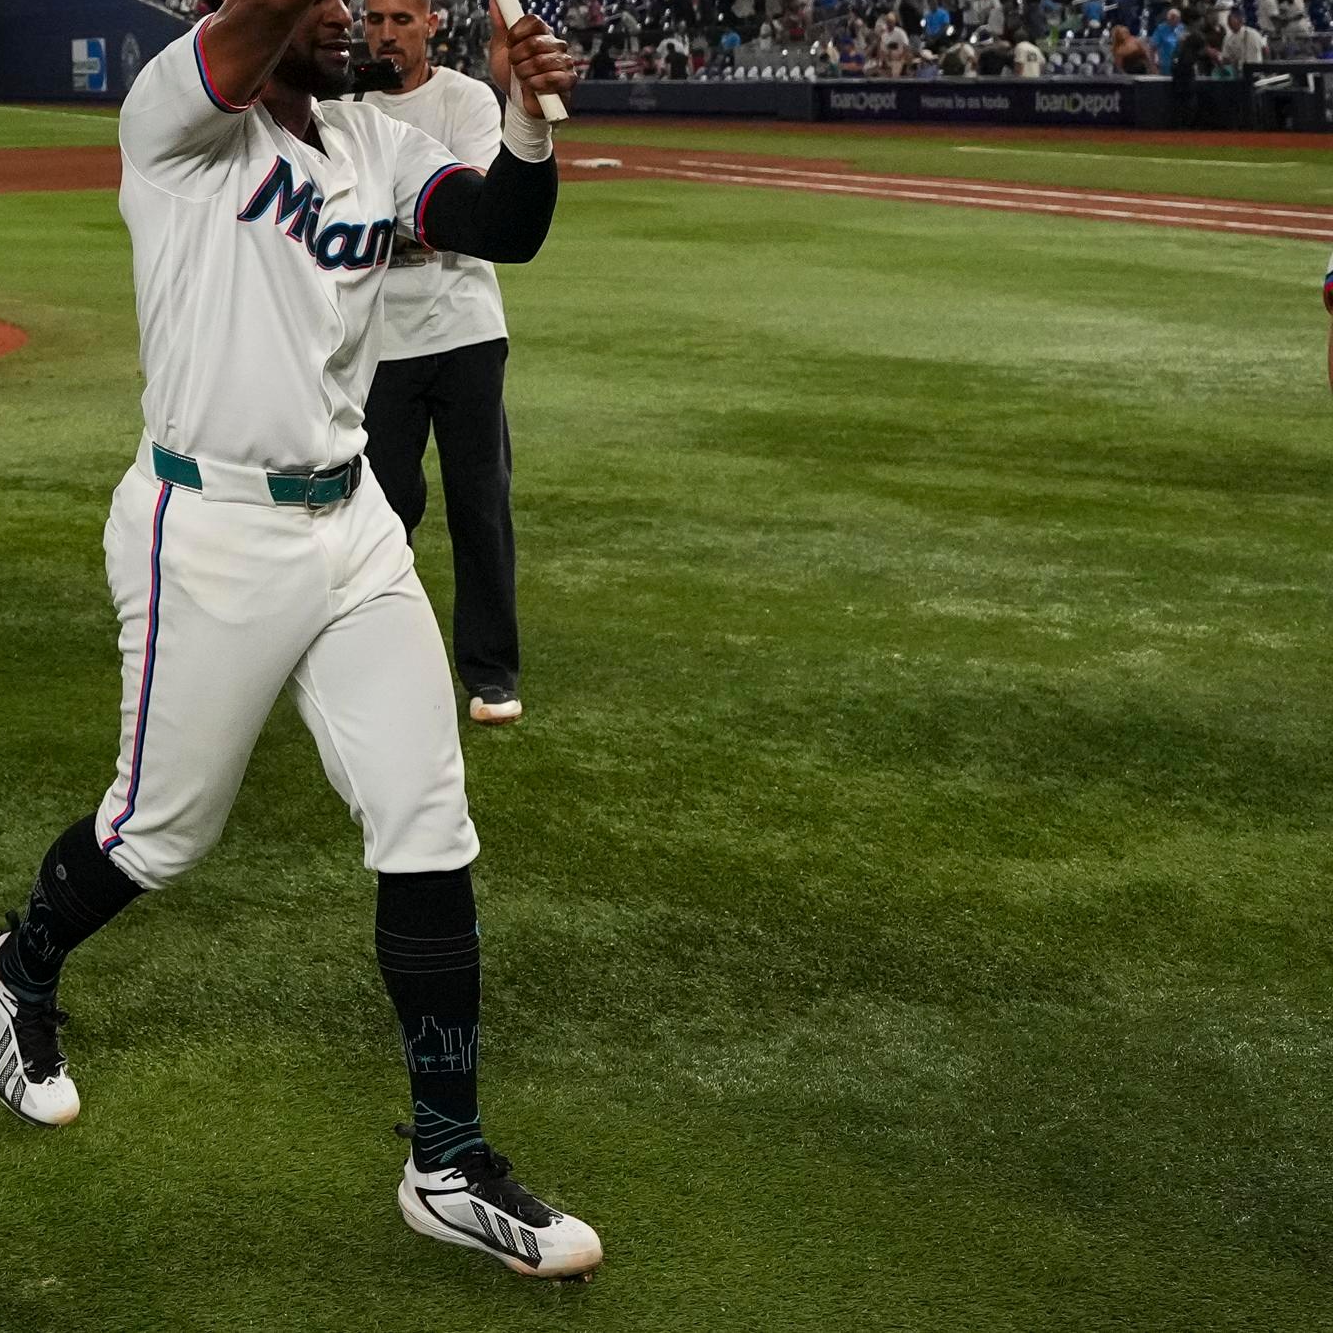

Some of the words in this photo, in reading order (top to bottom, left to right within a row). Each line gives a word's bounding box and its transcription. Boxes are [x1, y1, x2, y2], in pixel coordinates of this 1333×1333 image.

[830, 91, 897, 112] loanDepot
[1035, 91, 1120, 115] loanDepot
[237, 155, 397, 270] Miam
